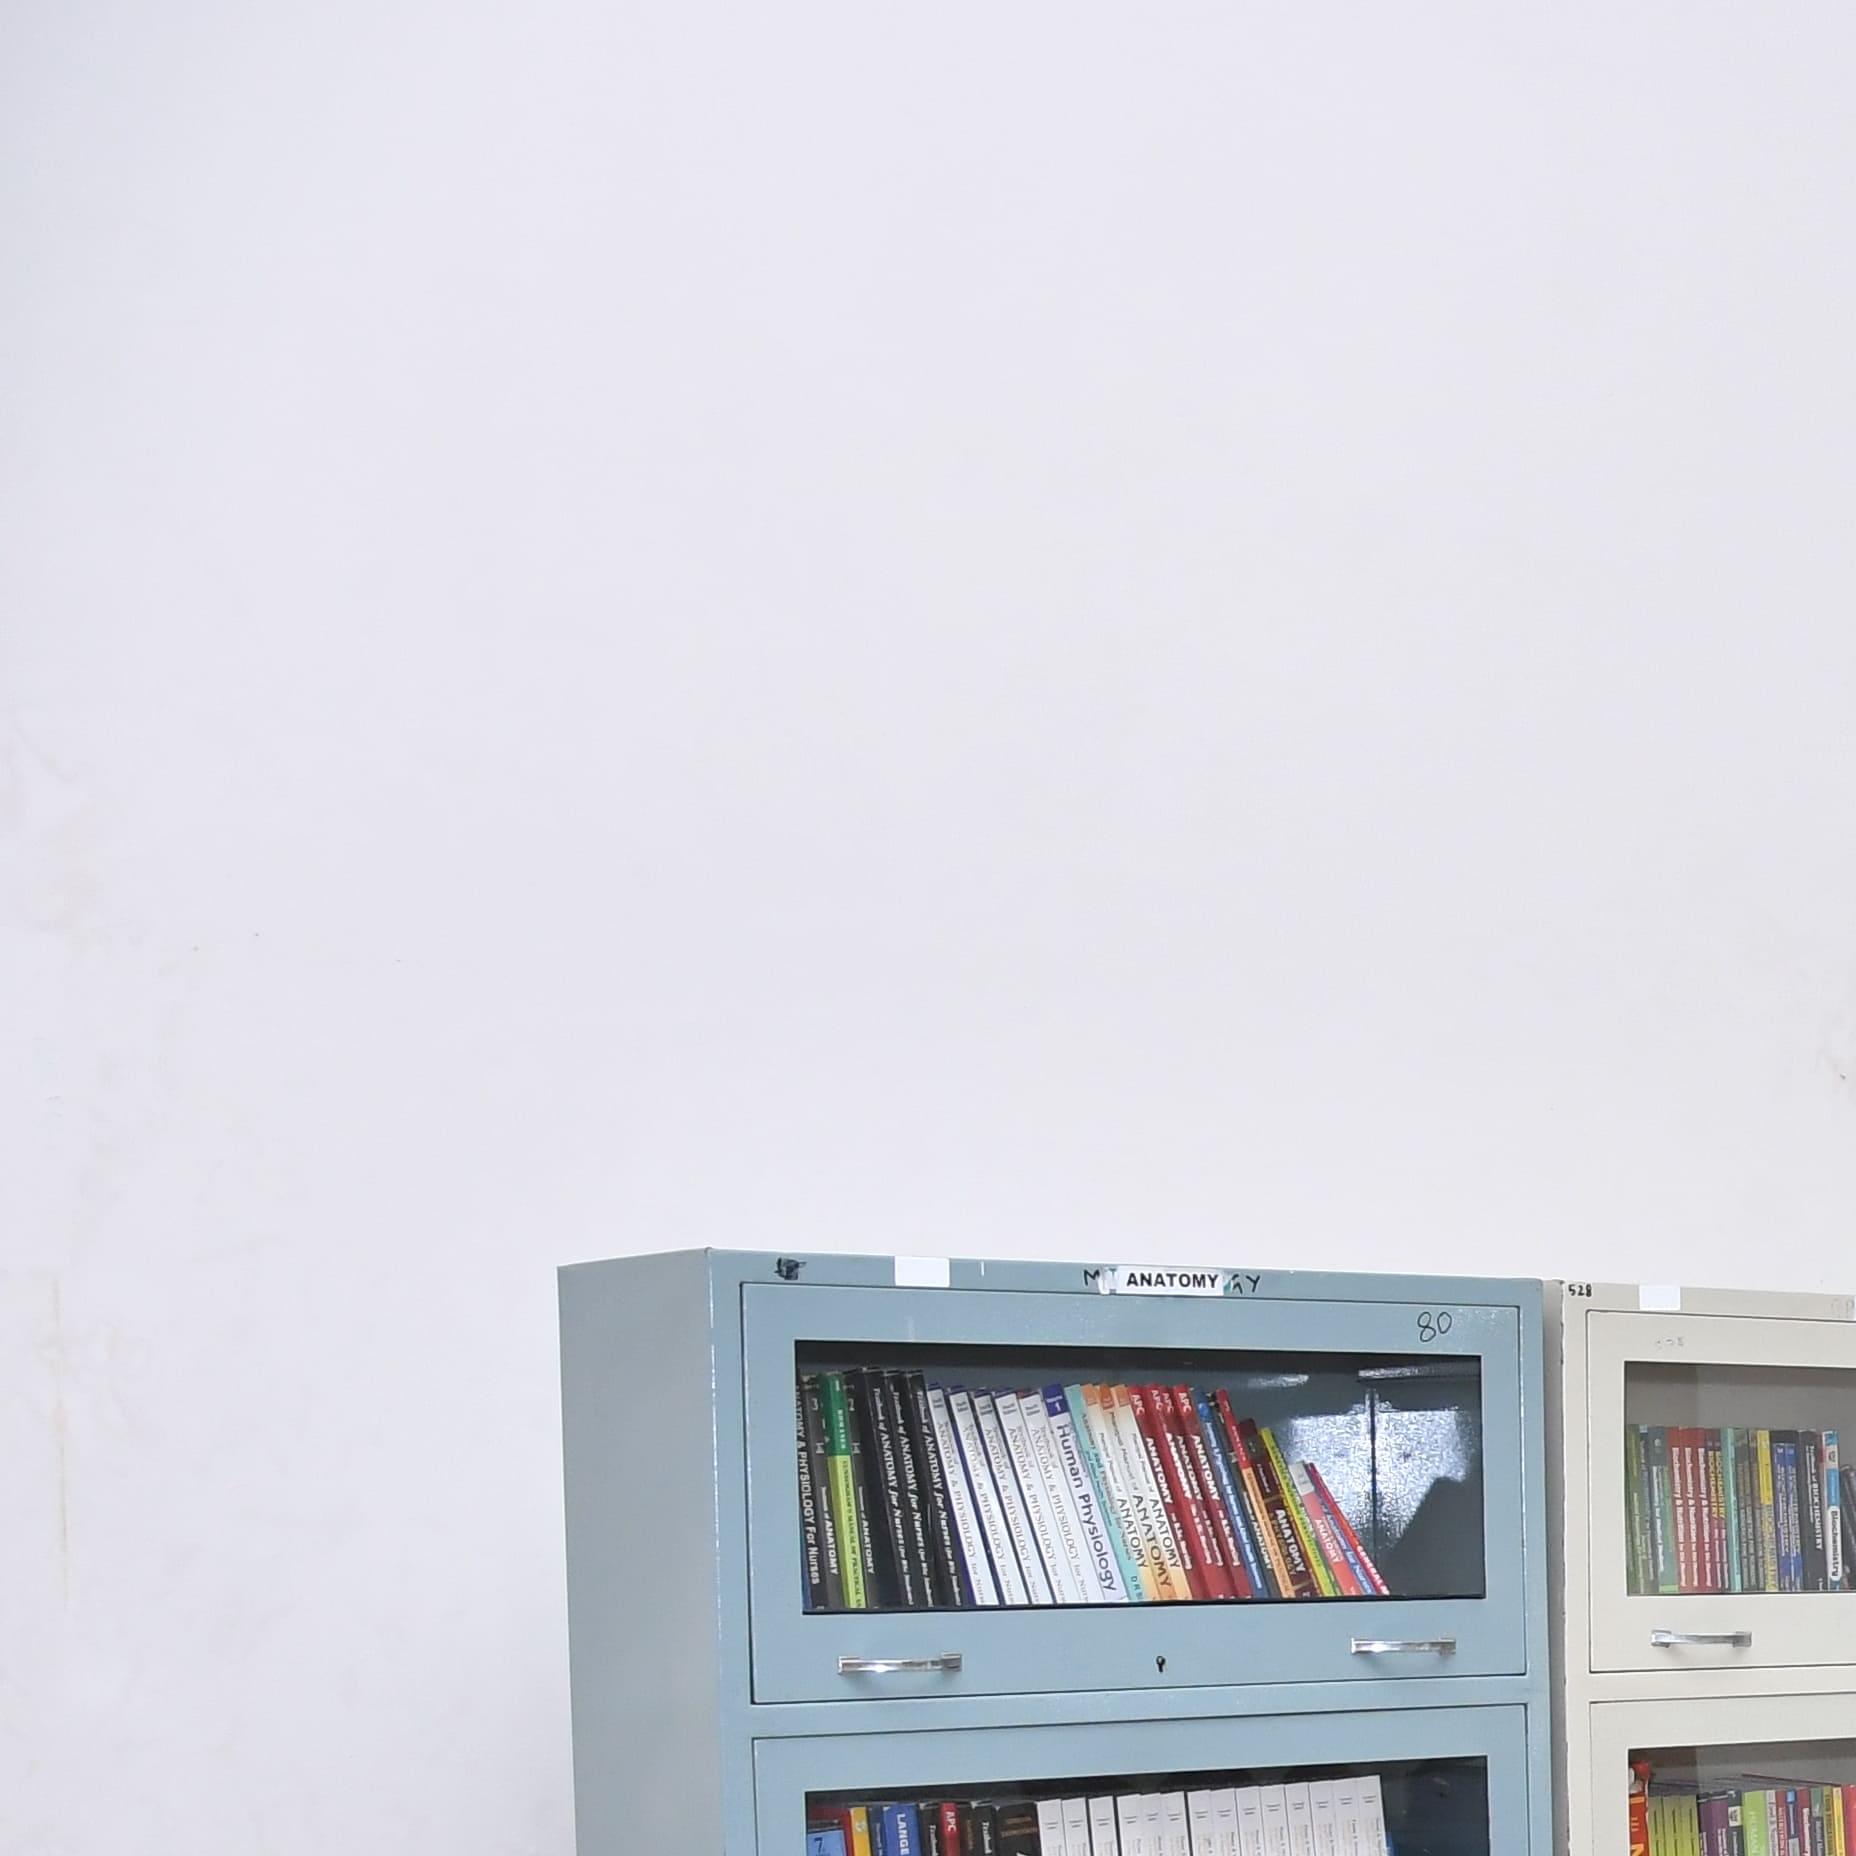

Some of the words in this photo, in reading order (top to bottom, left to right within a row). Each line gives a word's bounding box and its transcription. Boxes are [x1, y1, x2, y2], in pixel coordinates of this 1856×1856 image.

[1127, 1273, 1218, 1288] ANATOMY
[1568, 1283, 1592, 1297] 528
[1417, 1310, 1452, 1342] 80
[880, 1431, 896, 1487] ANATOMY
[1130, 1392, 1145, 1417] APC
[1145, 1436, 1172, 1505] ANATOMY
[1150, 1388, 1164, 1411] APC
[1165, 1431, 1192, 1500] ANATOMY
[1176, 1434, 1203, 1502] ANATOMY
[1177, 1390, 1192, 1413] APC
[1191, 1433, 1219, 1502] ANATOMY
[798, 1451, 813, 1522] PHYSIOLOGY
[887, 1488, 900, 1507] for
[899, 1435, 916, 1491] ANATOMY
[912, 1511, 925, 1547] Nurses
[924, 1435, 941, 1490] ANATOMY
[937, 1509, 950, 1546] Nurses
[1056, 1423, 1086, 1489] Human
[1076, 1492, 1118, 1593] Physiology
[1714, 1451, 1725, 1518] BIOCHEMISTRY
[1811, 1483, 1822, 1550] BIOCHEMISTRY
[805, 1525, 816, 1544] For
[825, 1520, 837, 1575] ANATOMY
[861, 1520, 873, 1574] ANATOMY
[892, 1509, 904, 1545] Nurses
[952, 1489, 977, 1558] PHYSIOLOGY
[979, 1493, 1005, 1560] PHYSIOLOGY
[1004, 1494, 1030, 1562] PHYSIOLOGY
[1028, 1493, 1054, 1561] PHYSIOLOGY
[1051, 1494, 1079, 1561] PHYSIOLOGY
[1115, 1496, 1149, 1569] ANATOMY
[1130, 1491, 1172, 1588] ANATOMY
[1147, 1496, 1181, 1570] ANATOMY
[1251, 1521, 1272, 1570] ANATOMY
[1275, 1507, 1305, 1574] ANATOMY
[1830, 1511, 1838, 1577] Biochemistry
[808, 1547, 819, 1584] Nurses
[897, 1813, 909, 1855] LANGE
[945, 1811, 956, 1833] APC
